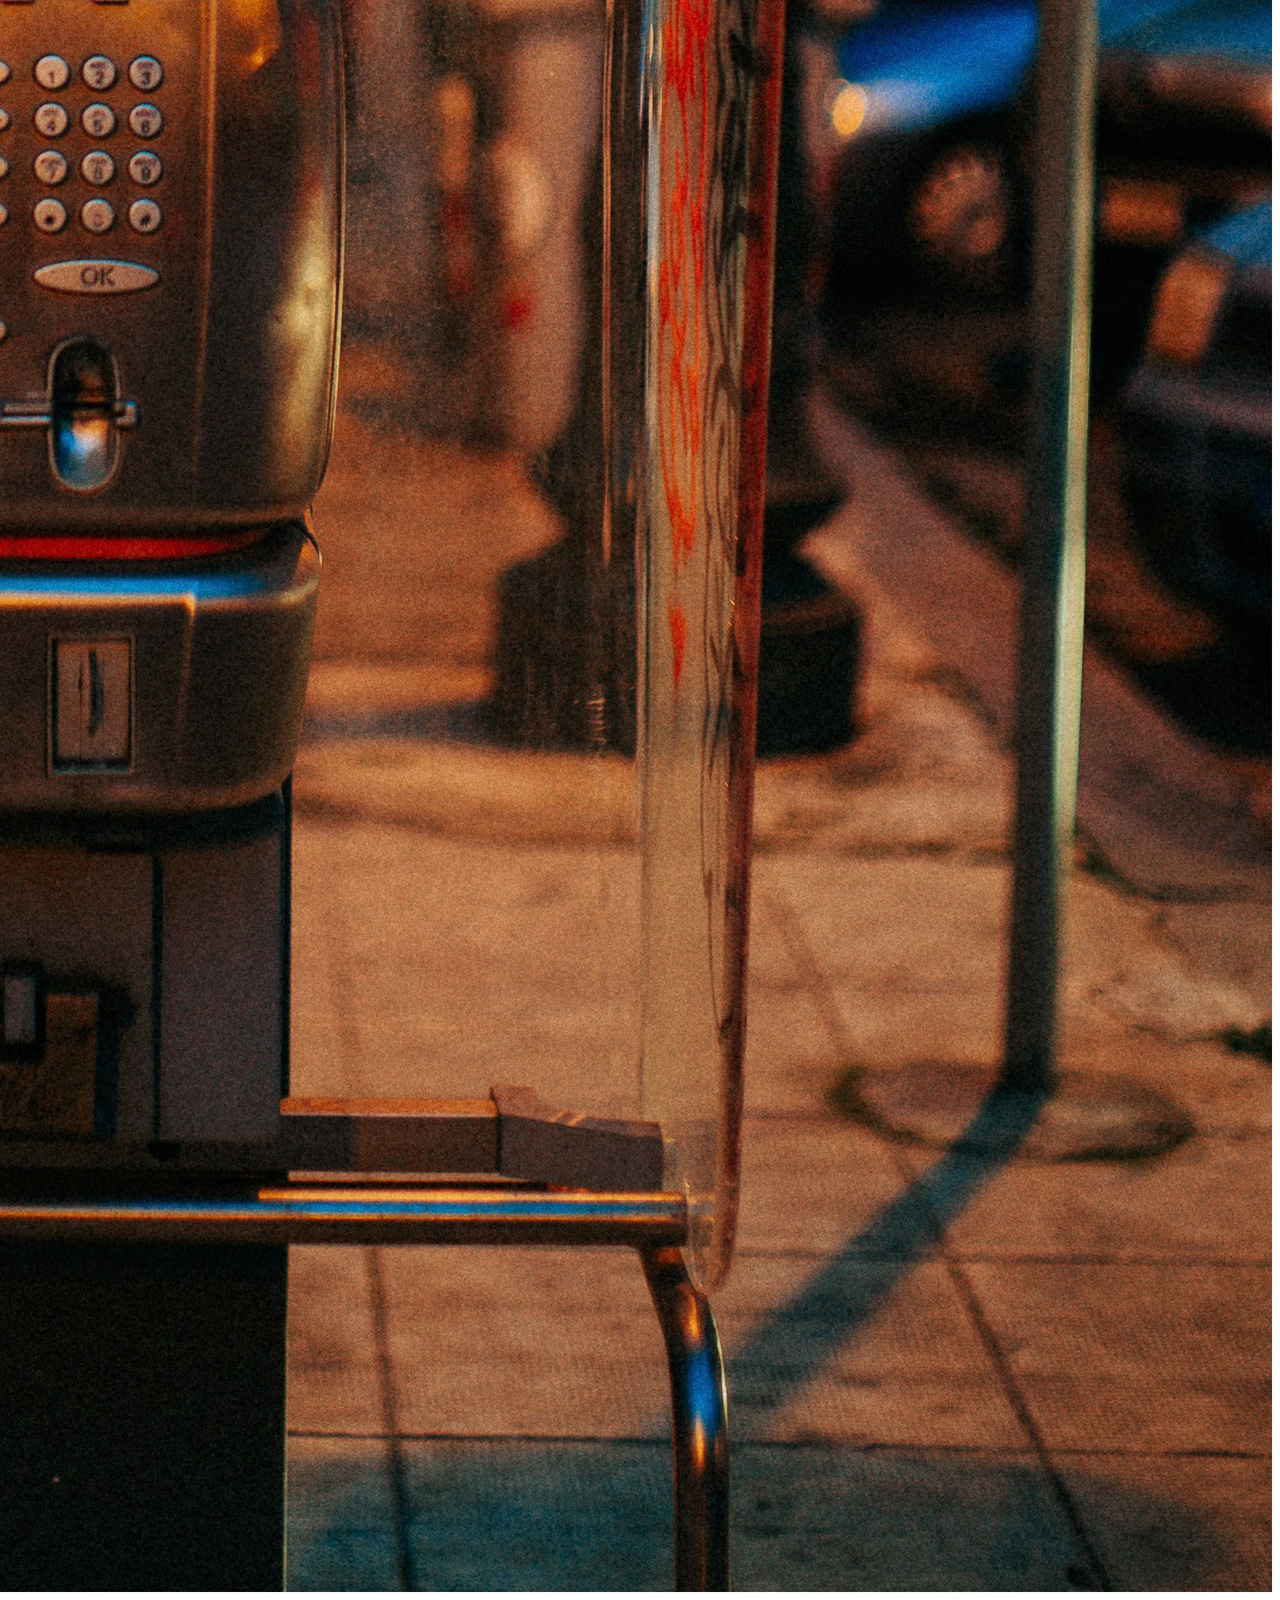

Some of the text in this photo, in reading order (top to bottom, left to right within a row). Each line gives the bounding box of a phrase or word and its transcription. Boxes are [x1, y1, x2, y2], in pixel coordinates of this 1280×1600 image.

[95, 72, 104, 84] 2
[142, 73, 150, 85] 3
[80, 267, 116, 287] OK
